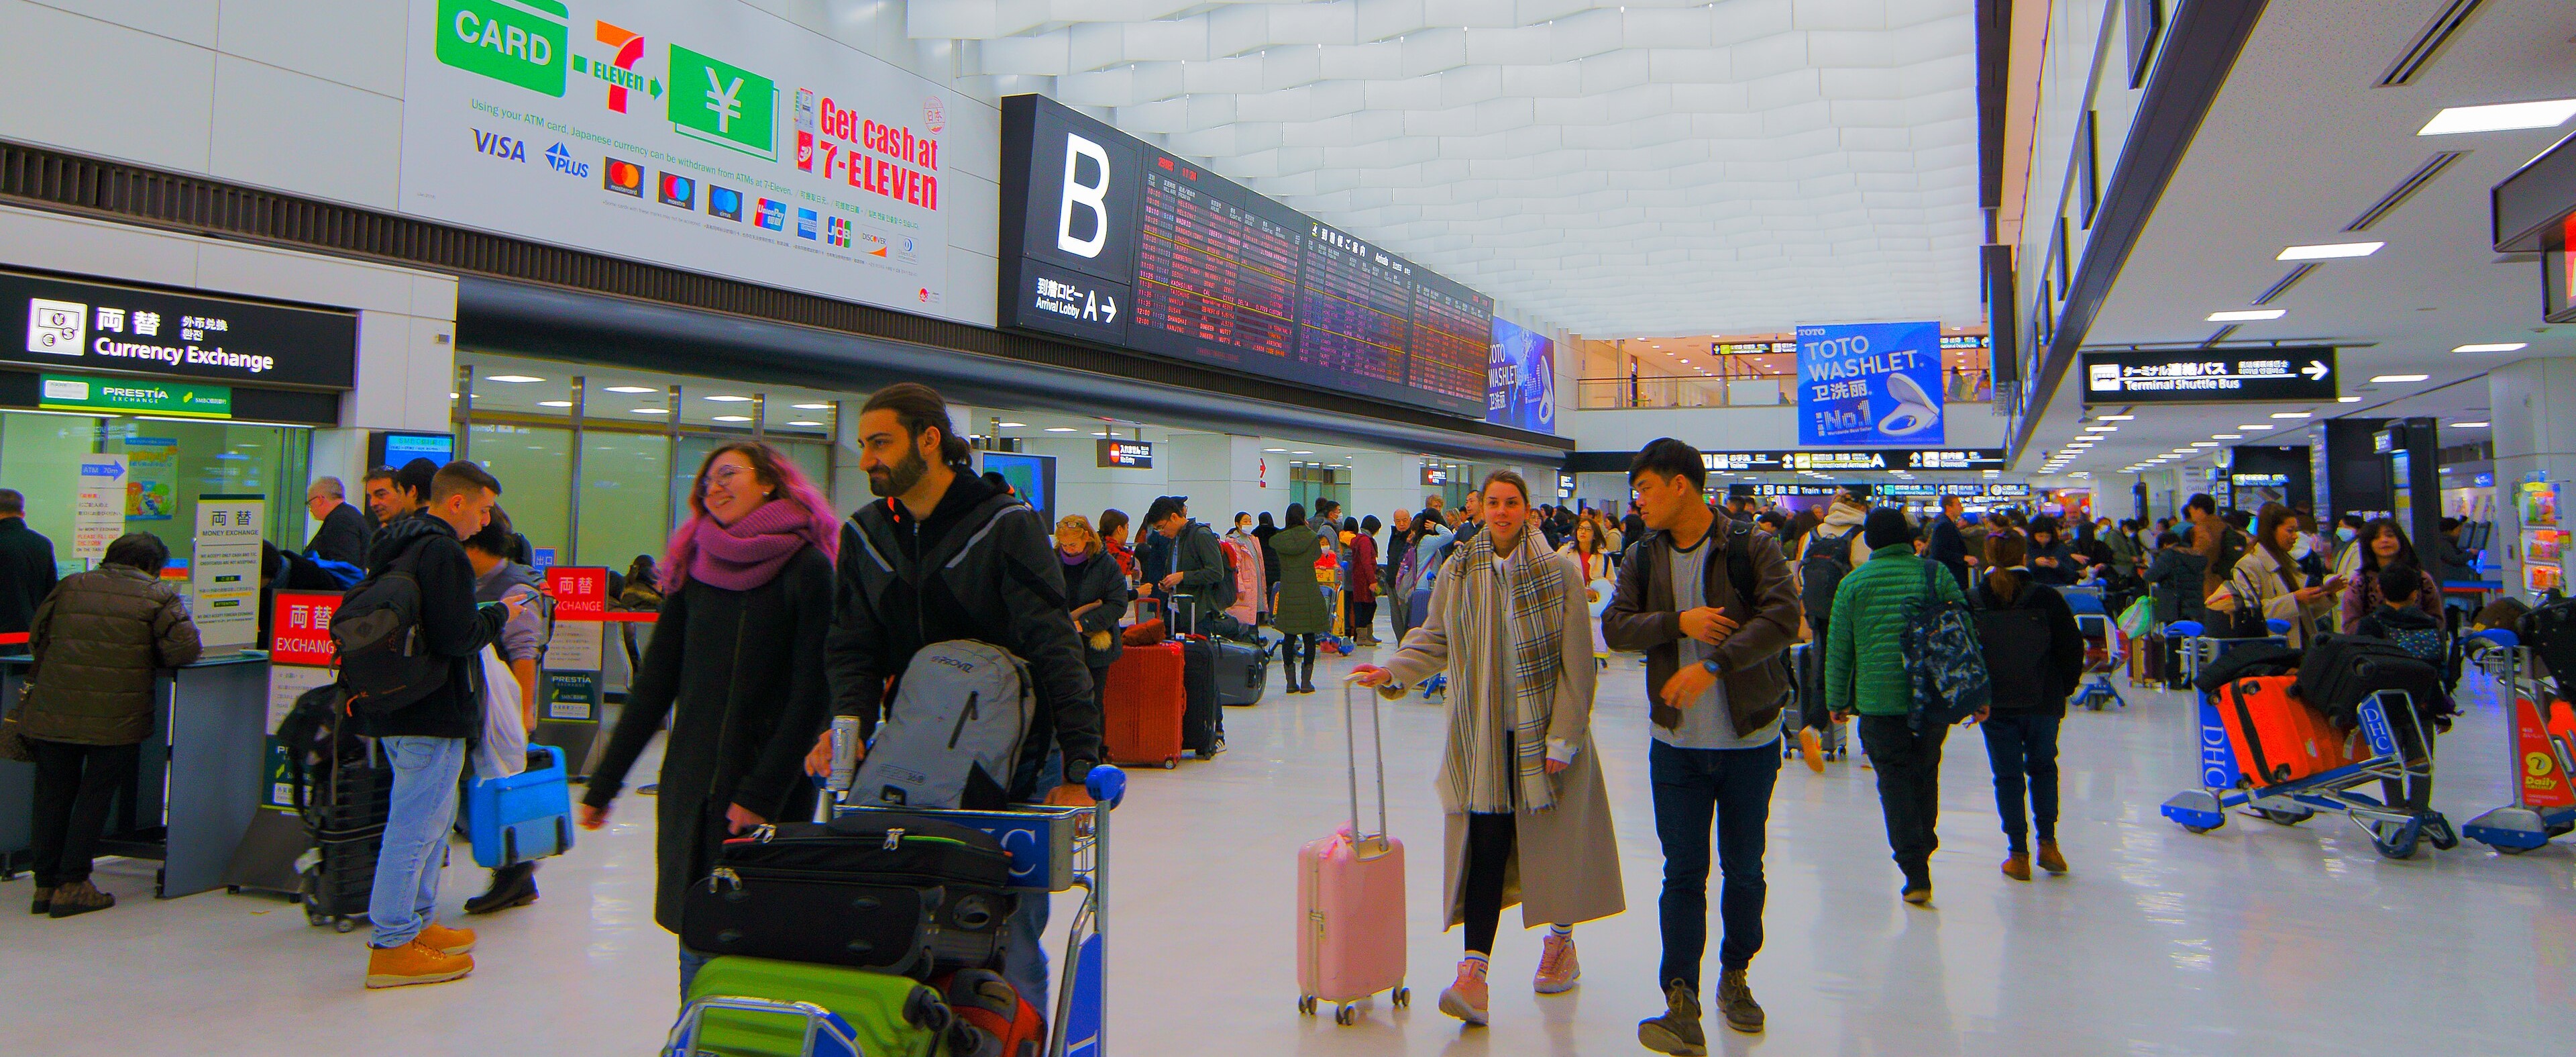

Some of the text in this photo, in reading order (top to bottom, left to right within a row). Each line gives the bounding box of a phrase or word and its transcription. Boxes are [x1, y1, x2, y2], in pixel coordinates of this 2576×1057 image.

[455, 10, 551, 66] CARD
[820, 97, 858, 144] Get
[863, 119, 914, 163] cash
[918, 139, 938, 171] at
[470, 128, 527, 164] VISA
[472, 99, 498, 117] Using
[501, 108, 521, 121] your
[525, 113, 544, 127] ATM
[572, 127, 612, 145] Japanese
[614, 140, 648, 157] currency
[651, 150, 664, 160] can
[667, 153, 676, 163] be
[678, 156, 716, 174] withdrawn
[718, 167, 735, 179] from
[736, 172, 753, 185] ATMs
[756, 179, 763, 187] at
[764, 179, 793, 195] 7-Eleven.
[556, 158, 590, 179] PLUS
[611, 185, 637, 195] mastercard
[1058, 132, 1110, 258] B
[667, 199, 686, 207] maestro
[758, 205, 784, 219] UnionPay
[1145, 205, 1159, 216] 10:10
[1175, 217, 1191, 228] MADRID
[1208, 229, 1222, 240] IBERIA
[828, 225, 851, 240] JCB
[862, 234, 886, 246] DISCOVER
[1142, 242, 1156, 253] 10:45
[1142, 252, 1155, 262] 10:45
[1173, 244, 1189, 255] TAIPEI
[1140, 261, 1184, 281] 11:00 SEOUL
[1037, 278, 1083, 301] 到着ロビー
[1138, 289, 1152, 298] 11:35
[1140, 270, 1153, 280] 11:25
[1156, 275, 1168, 285] 11:00
[1170, 279, 1193, 292] KAOHSIUNG
[1236, 299, 1248, 308] DELTA
[1269, 308, 1282, 317] CUSTOMS
[1036, 297, 1080, 319] Arrival Lobby
[1083, 290, 1097, 321] A
[1138, 298, 1151, 307] 11:35
[95, 307, 160, 336] 両替
[180, 315, 228, 332] 外币兑换
[1136, 316, 1149, 325] 12:00
[1137, 307, 1187, 326] 12:00 SHANGHAI
[180, 330, 203, 341] 환전
[95, 338, 274, 373] Currency Exchange
[1805, 336, 1868, 360] TOTO
[1808, 350, 1917, 382] WASHLET
[2123, 362, 2226, 376] ターミナル連絡バス
[1812, 379, 1867, 402] 卫洗丽
[2125, 378, 2241, 391] Terminal Shuttle Bus
[1823, 400, 1871, 430] No.1
[83, 466, 99, 474] ATM
[1870, 453, 1885, 468] A
[211, 510, 252, 526] 両替
[537, 556, 553, 565] 出口
[553, 576, 593, 595] 両替
[548, 601, 602, 611] XCHANGE
[282, 605, 331, 630] 両替
[270, 638, 336, 654] EXCHANG
[2363, 708, 2390, 750] DHC
[2202, 725, 2226, 787] DHC
[2525, 776, 2557, 791] Daily
